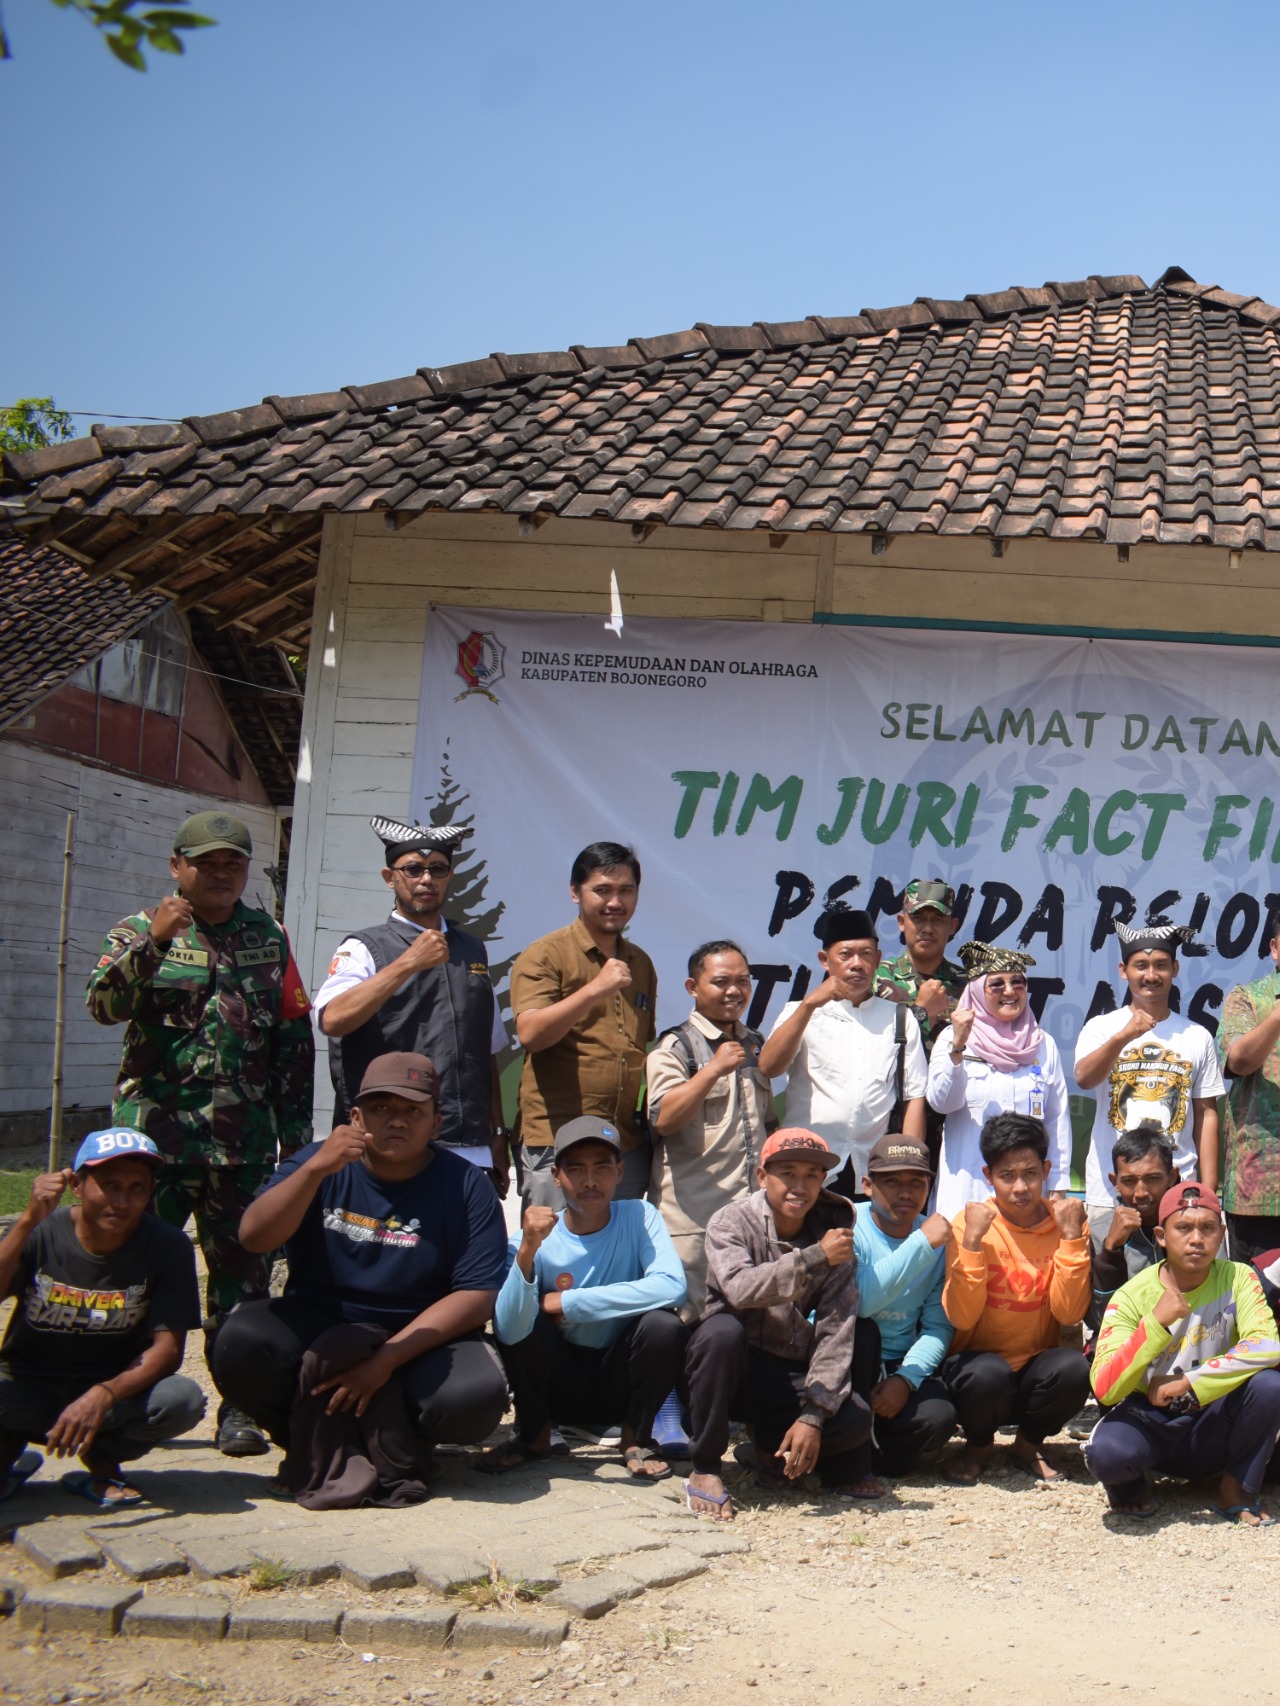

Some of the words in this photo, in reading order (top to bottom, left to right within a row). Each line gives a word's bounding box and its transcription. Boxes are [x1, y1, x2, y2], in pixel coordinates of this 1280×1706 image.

[521, 651, 570, 666] DINAS
[574, 654, 686, 671] KEPEMUDAAN
[690, 659, 725, 674] DAN
[729, 661, 819, 678] OLAHRAGA
[521, 668, 607, 683] KABUPATEN
[610, 672, 707, 688] BOJONEGORO
[880, 701, 1106, 749] SELAMAT
[671, 770, 804, 841] TIM
[816, 776, 980, 849] JURI
[1000, 784, 1187, 862] FACT
[242, 953, 259, 963] TNI
[263, 950, 276, 960] AD
[1143, 1047, 1163, 1055] SMF
[96, 1132, 148, 1153] BOY
[48, 1284, 126, 1310] DRIVER
